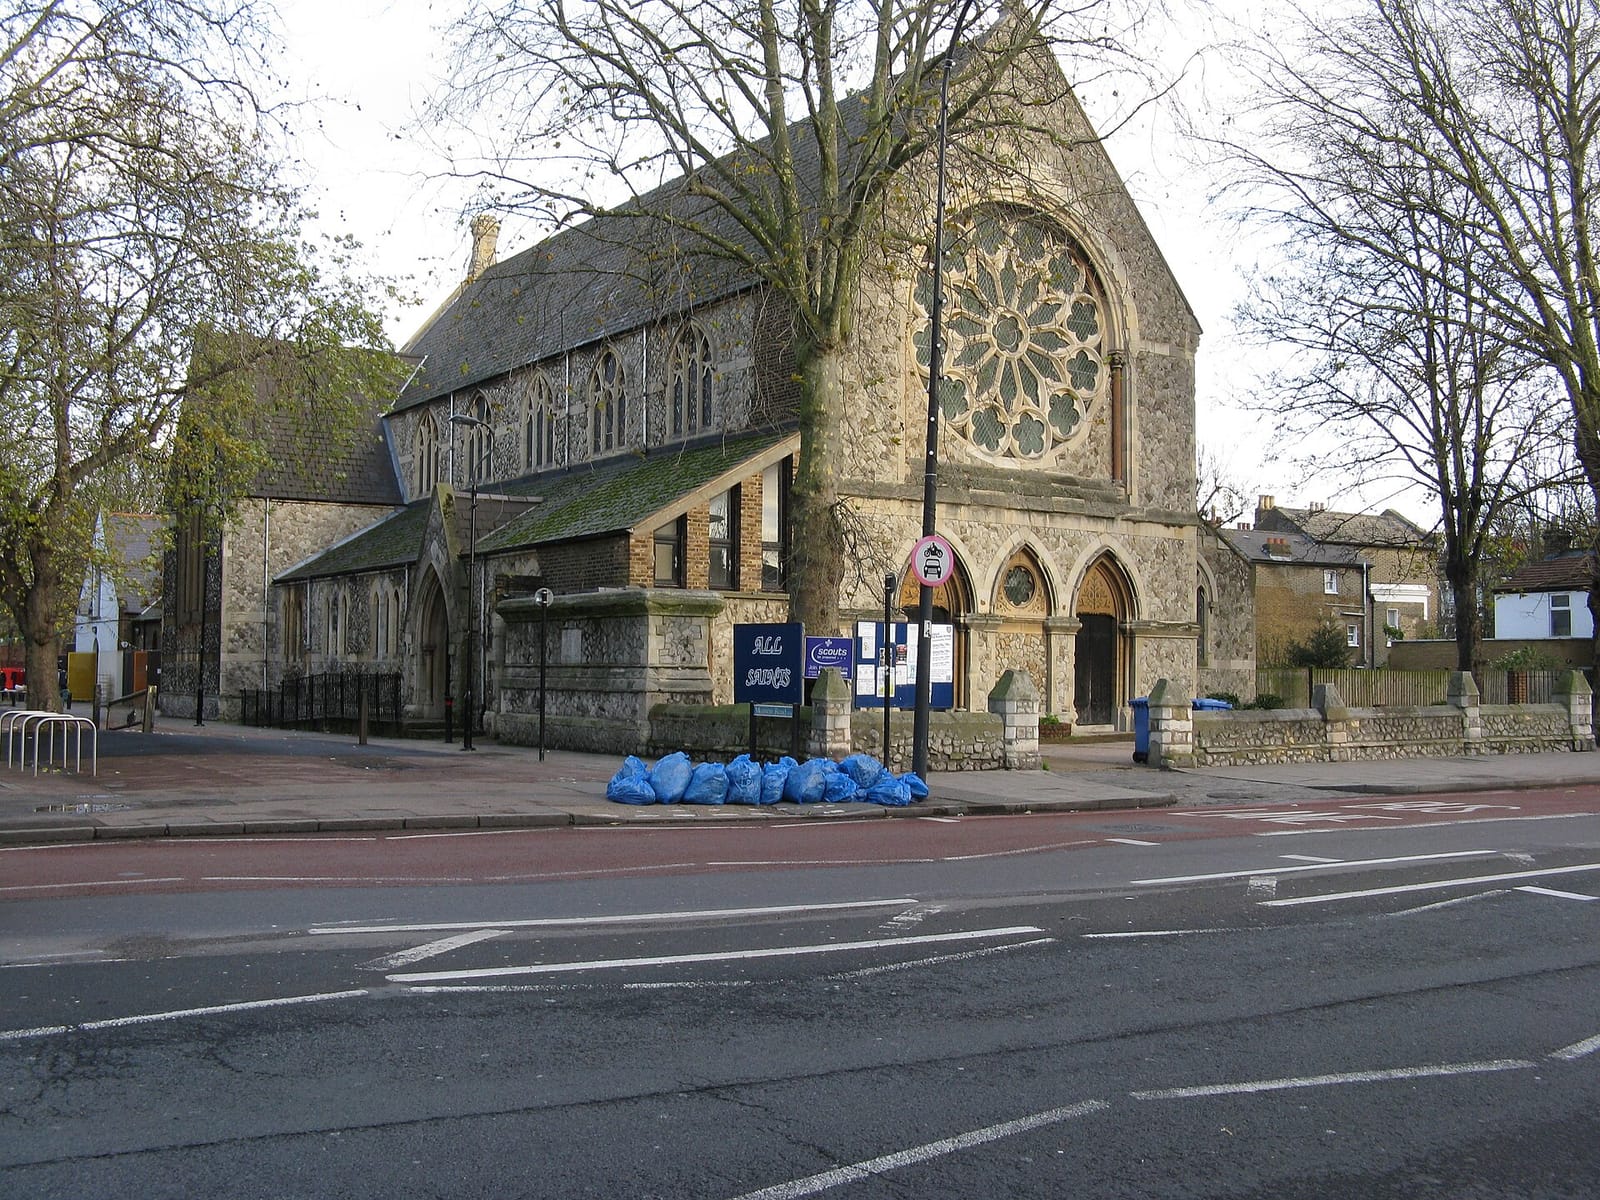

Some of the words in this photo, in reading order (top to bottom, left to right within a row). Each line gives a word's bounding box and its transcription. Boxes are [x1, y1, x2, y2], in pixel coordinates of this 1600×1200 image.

[752, 636, 782, 654] ALL
[818, 648, 847, 656] scouts
[746, 667, 791, 689] SAINTS
